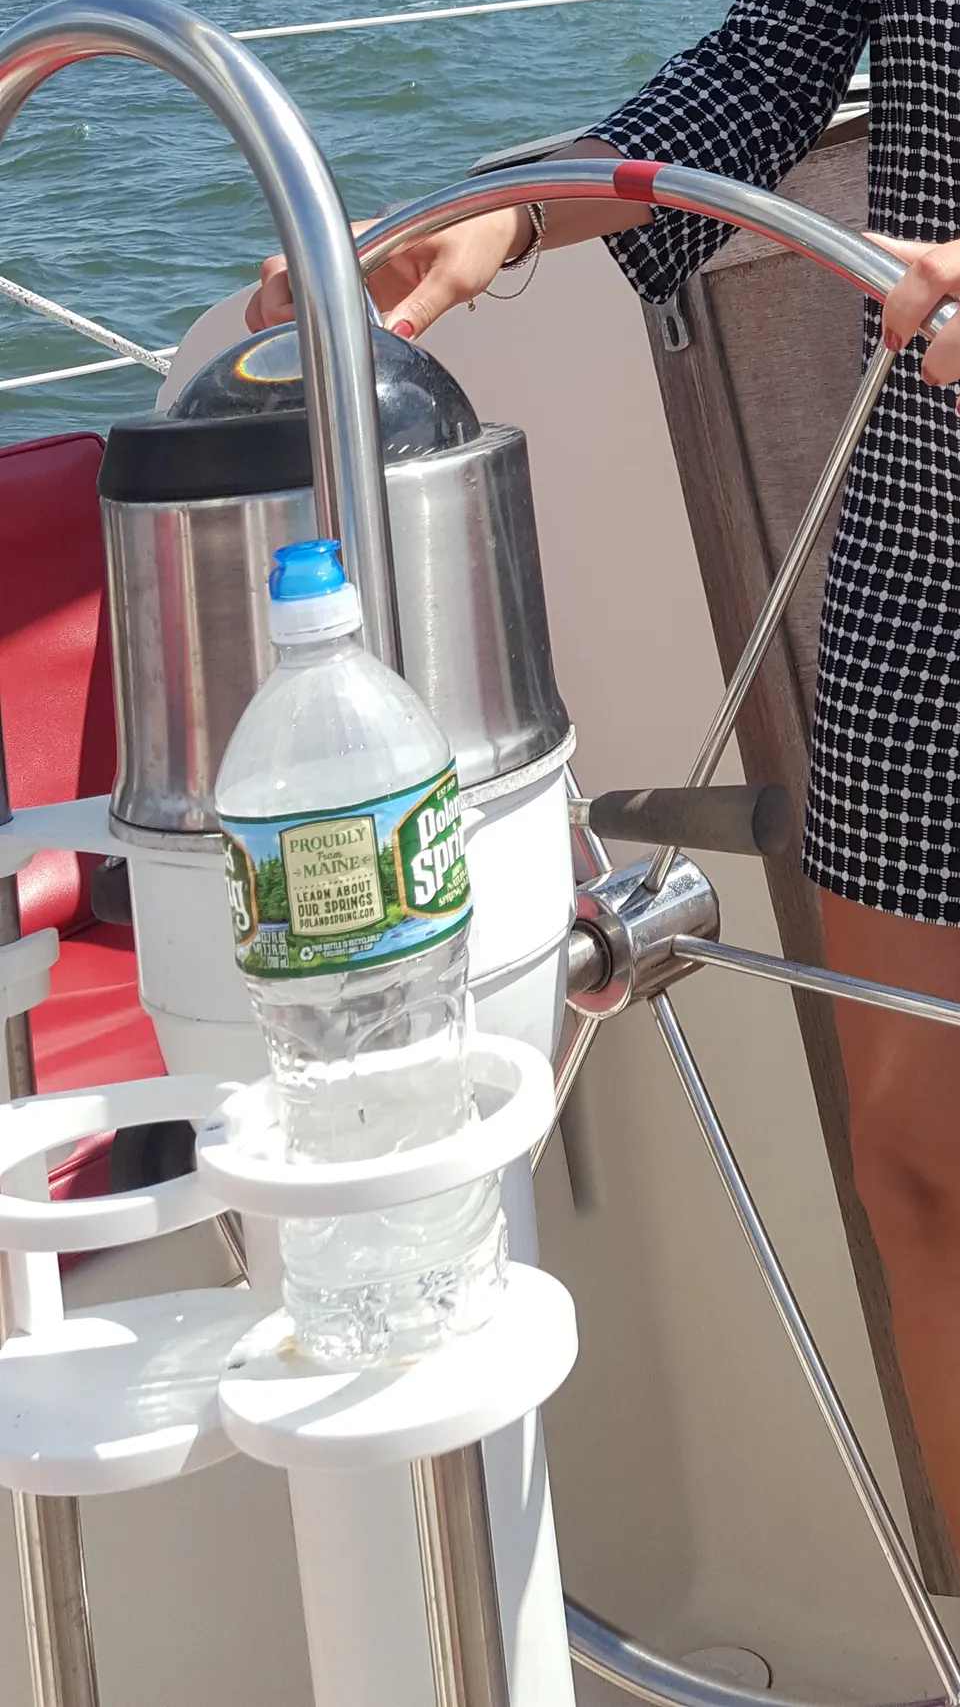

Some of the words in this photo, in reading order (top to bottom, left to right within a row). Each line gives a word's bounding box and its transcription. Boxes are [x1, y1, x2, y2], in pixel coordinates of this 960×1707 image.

[417, 795, 460, 851] Polan
[289, 827, 366, 853] PROUDLY
[303, 856, 360, 878] MAINE
[316, 851, 343, 862] From
[411, 822, 465, 905] Spri
[297, 888, 331, 902] LEARN
[337, 880, 371, 898] ABOUT
[298, 903, 320, 917] OUR
[325, 892, 373, 913] SPRINGS
[300, 907, 375, 929] POLANDSPRING.COM
